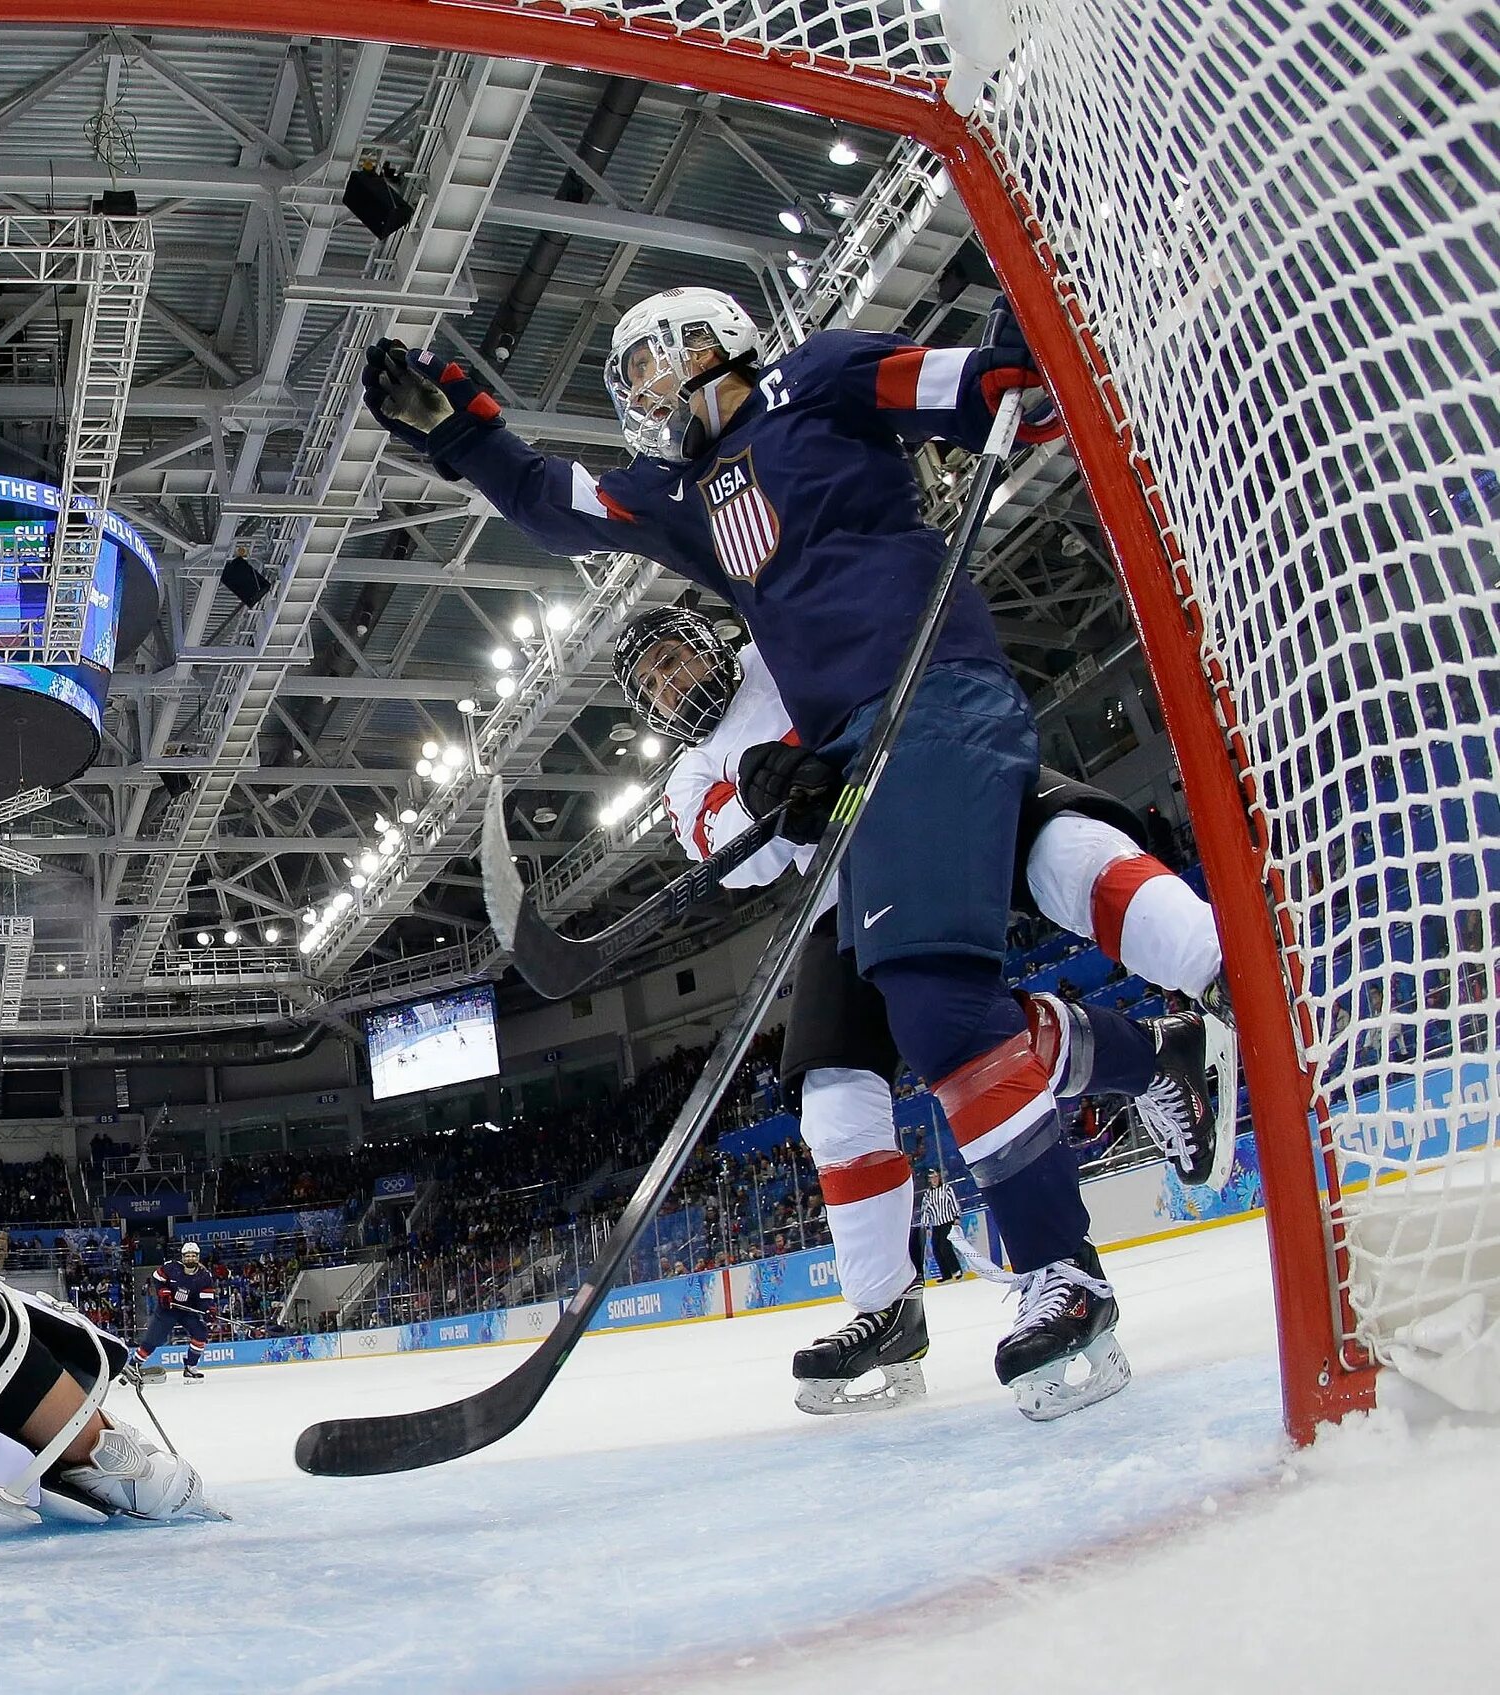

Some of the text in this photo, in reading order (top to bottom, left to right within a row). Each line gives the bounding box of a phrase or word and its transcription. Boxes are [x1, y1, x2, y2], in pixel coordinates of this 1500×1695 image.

[759, 368, 790, 412] C
[708, 465, 747, 505] USA
[14, 526, 45, 542] SUI
[667, 824, 764, 919] BAUER
[101, 1115, 113, 1123] B5
[238, 1226, 275, 1238] YOURS
[809, 1260, 838, 1287] СОЧ
[608, 1293, 661, 1319] SOCHI 2014
[161, 1348, 235, 1365] SOC 2014
